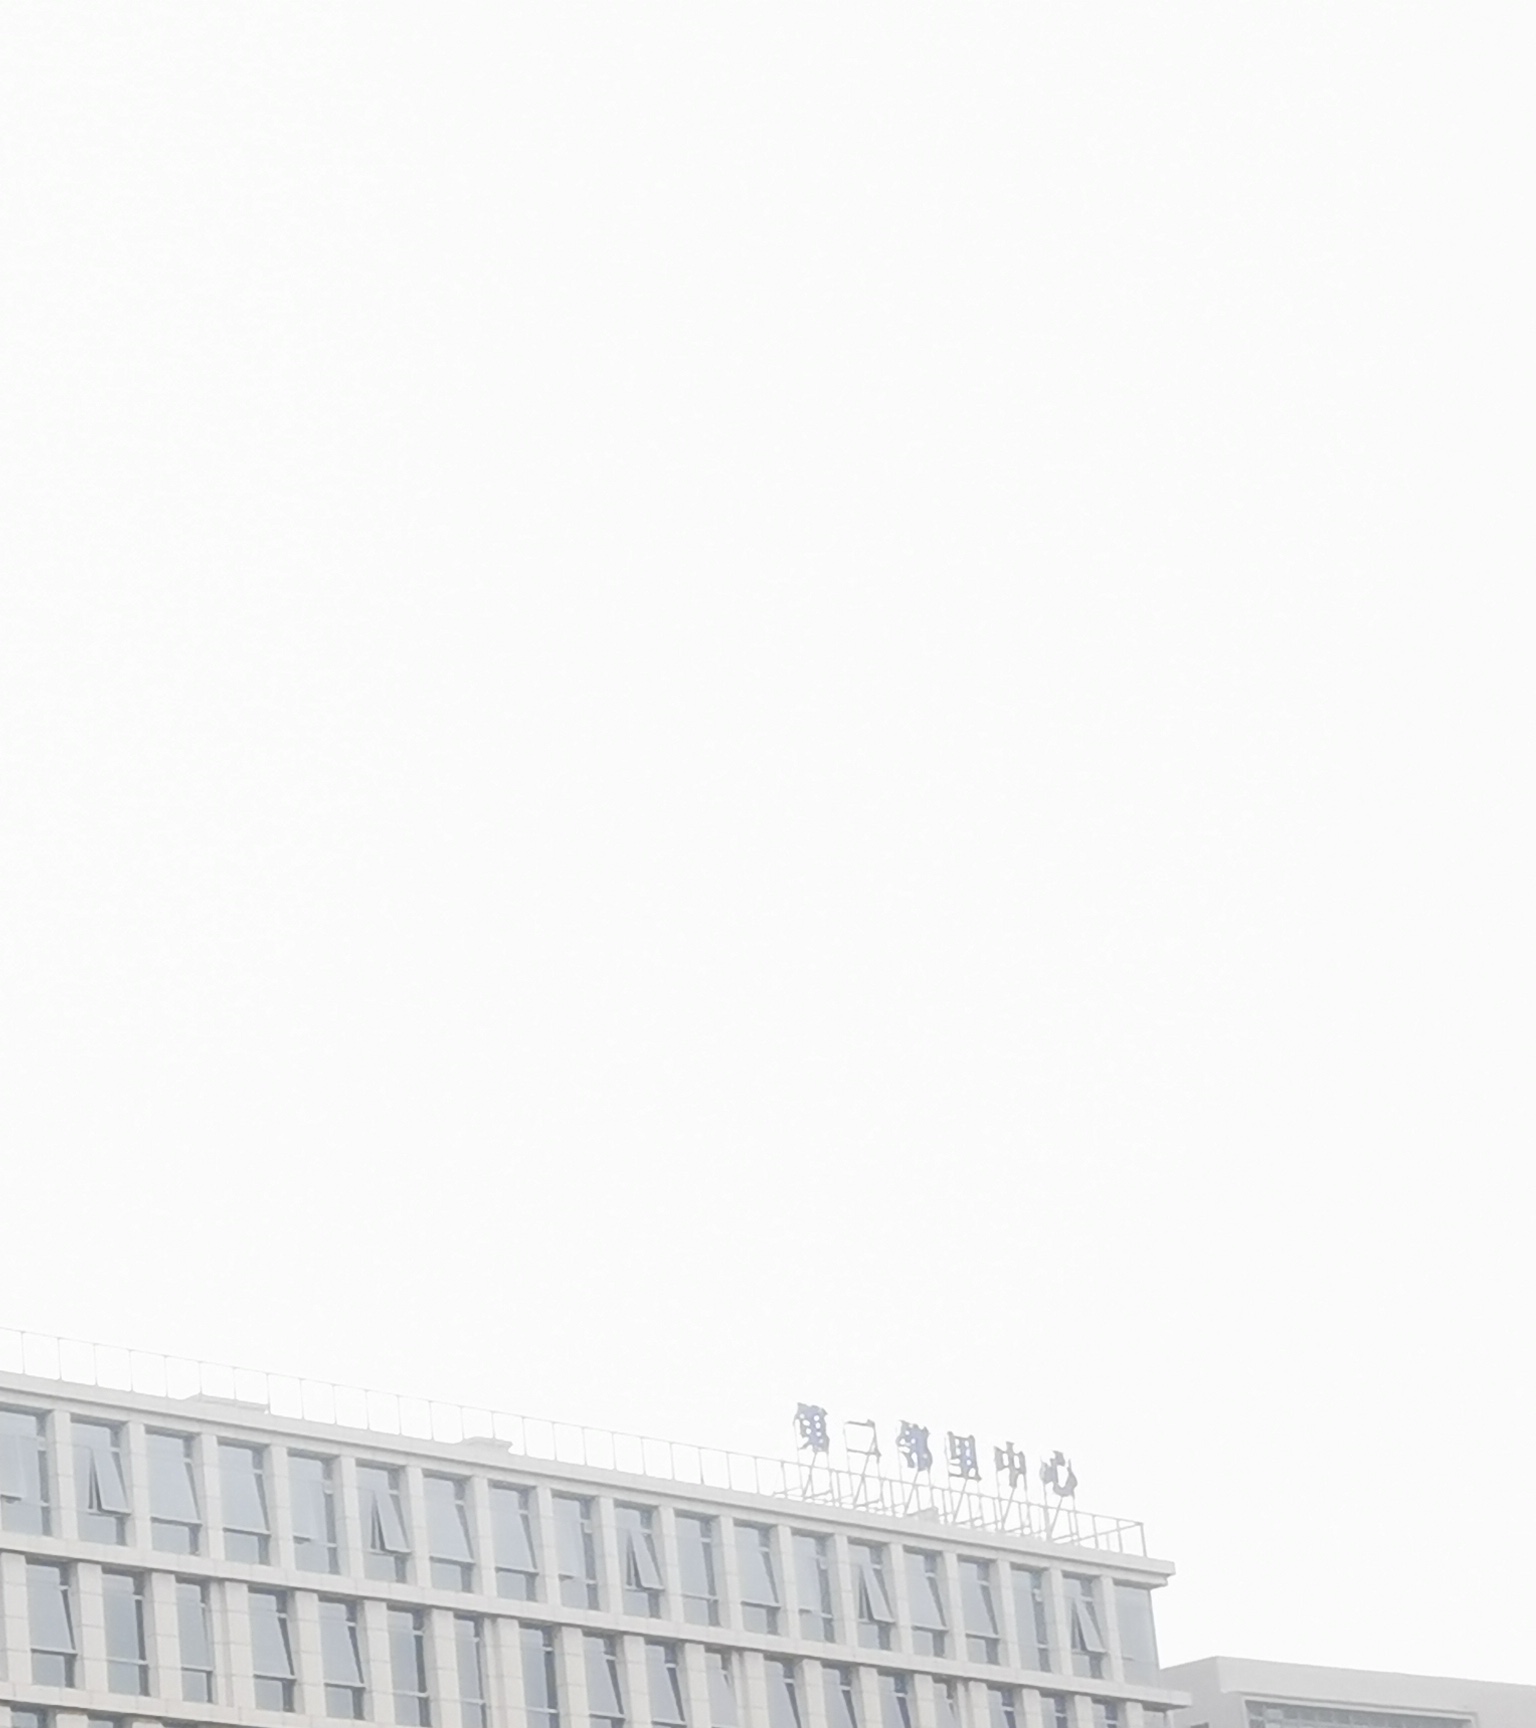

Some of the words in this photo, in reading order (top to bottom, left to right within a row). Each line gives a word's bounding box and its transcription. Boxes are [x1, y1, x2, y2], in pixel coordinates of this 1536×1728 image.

[793, 1402, 1078, 1498] 第二邻里中心
